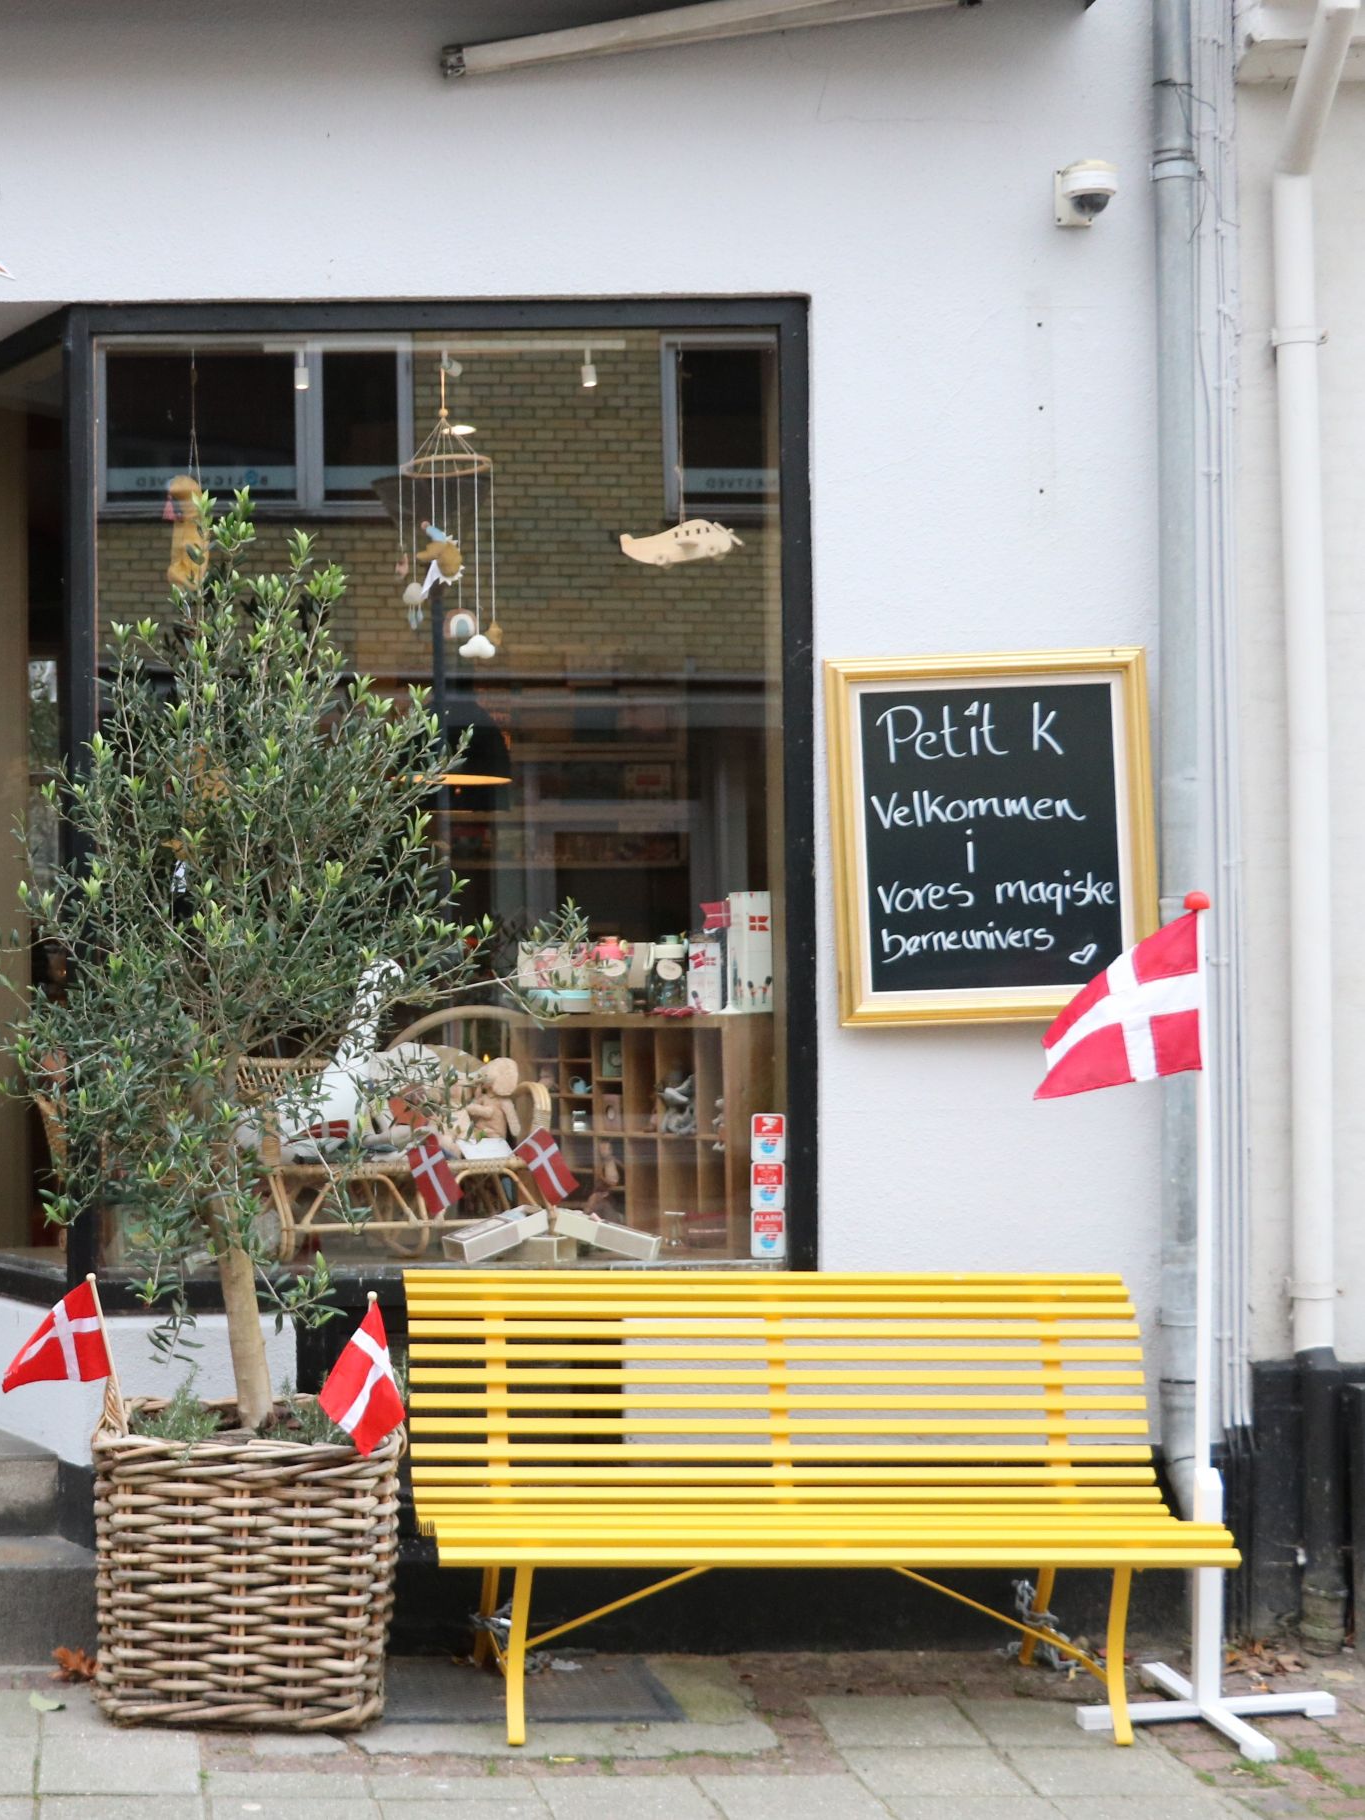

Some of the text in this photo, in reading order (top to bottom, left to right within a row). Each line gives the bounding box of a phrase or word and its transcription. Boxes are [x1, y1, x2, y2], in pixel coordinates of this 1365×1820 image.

[875, 700, 1010, 763] Petit
[870, 789, 1086, 829] Velkommen
[964, 828, 975, 874] i
[995, 869, 1115, 915] magiske
[881, 920, 1055, 964] børneunivers
